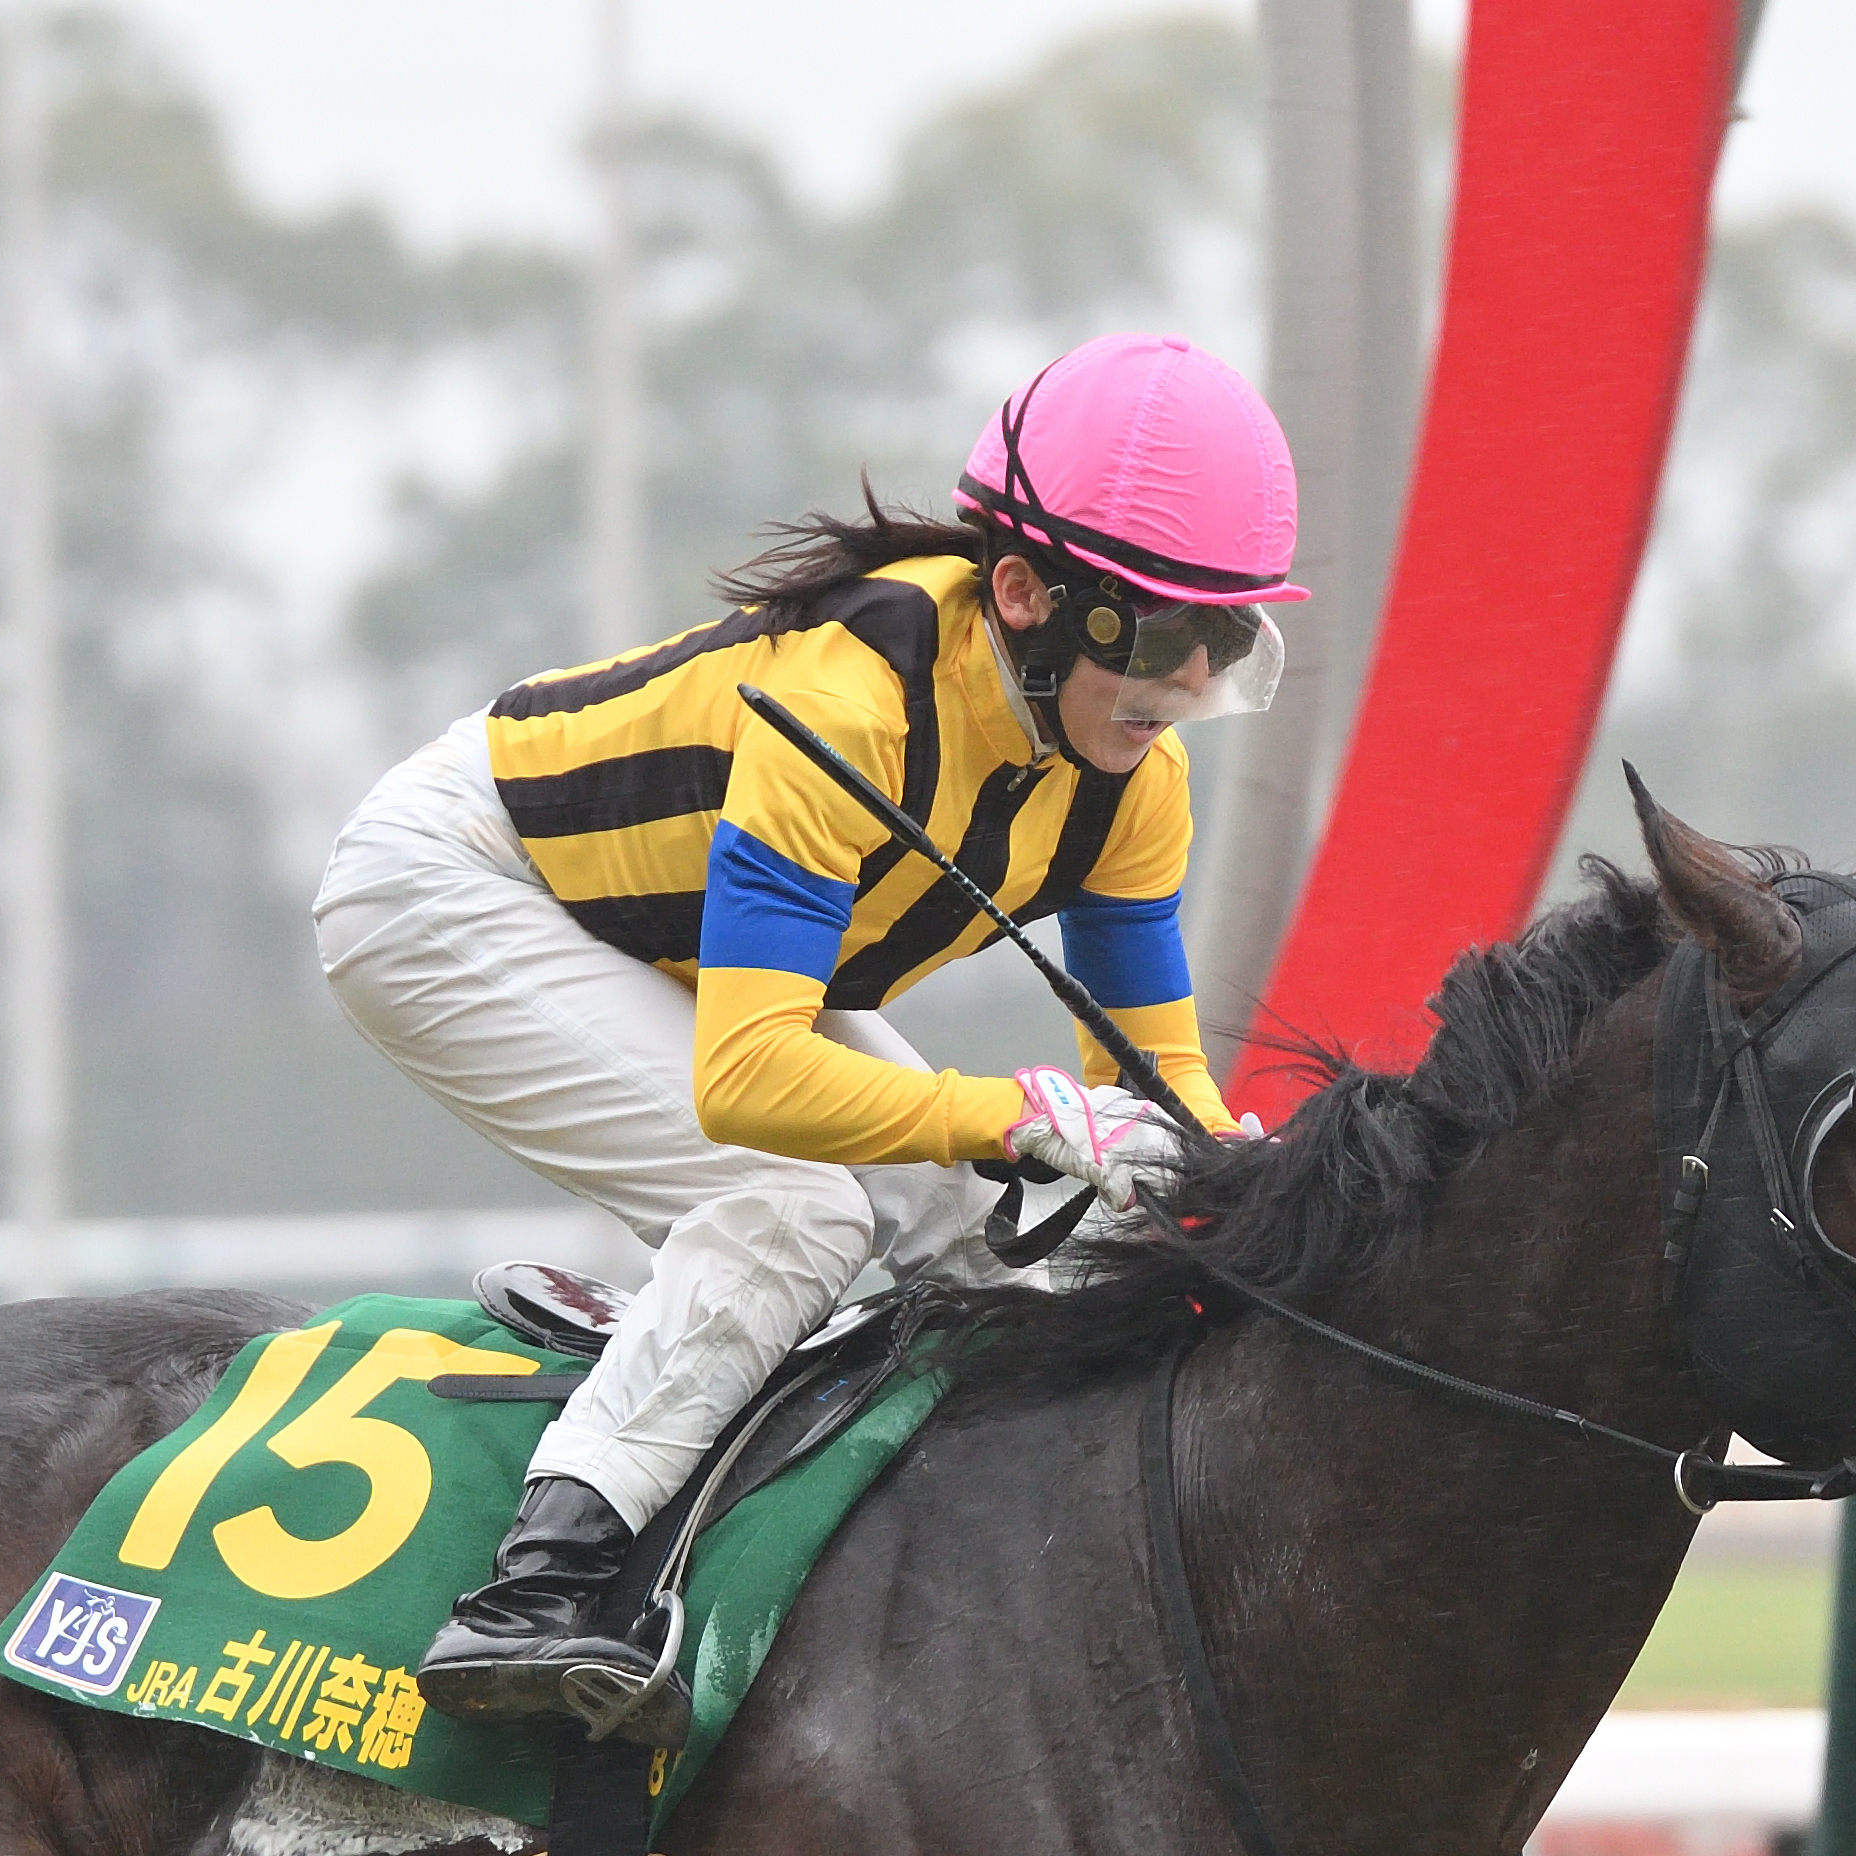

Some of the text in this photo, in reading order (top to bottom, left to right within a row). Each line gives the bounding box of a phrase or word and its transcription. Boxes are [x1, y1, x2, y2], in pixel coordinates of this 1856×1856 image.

[118, 1320, 541, 1599] 15
[34, 1598, 128, 1676] YJS
[126, 1659, 199, 1708] JRA
